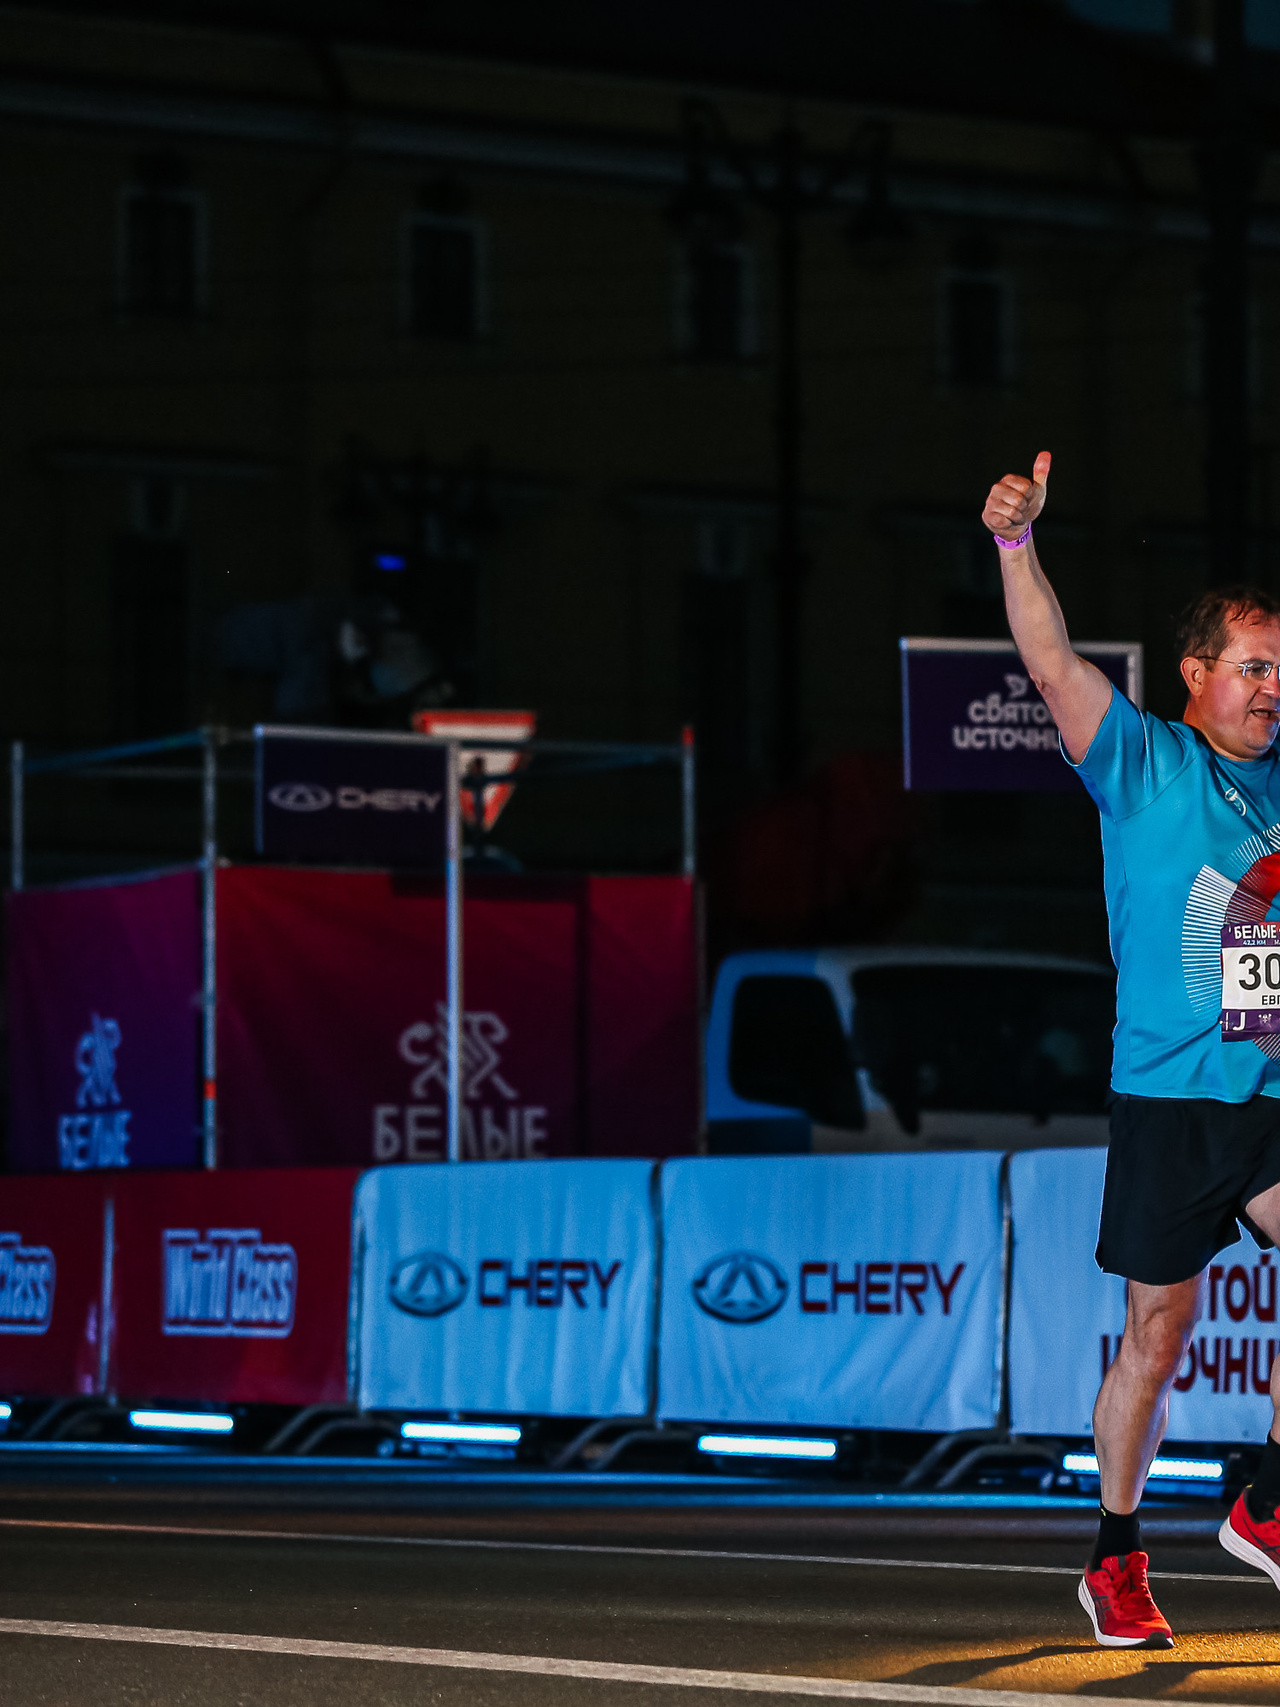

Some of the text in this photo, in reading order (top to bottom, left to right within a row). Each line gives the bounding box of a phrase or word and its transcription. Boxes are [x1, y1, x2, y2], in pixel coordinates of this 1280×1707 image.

[966, 691, 1053, 725] свято
[336, 785, 442, 813] CHERY
[1233, 924, 1277, 941] БЕЛЫЕ
[1232, 1011, 1246, 1031] J
[478, 1259, 622, 1310] CHERY
[799, 1261, 966, 1316] CHERY
